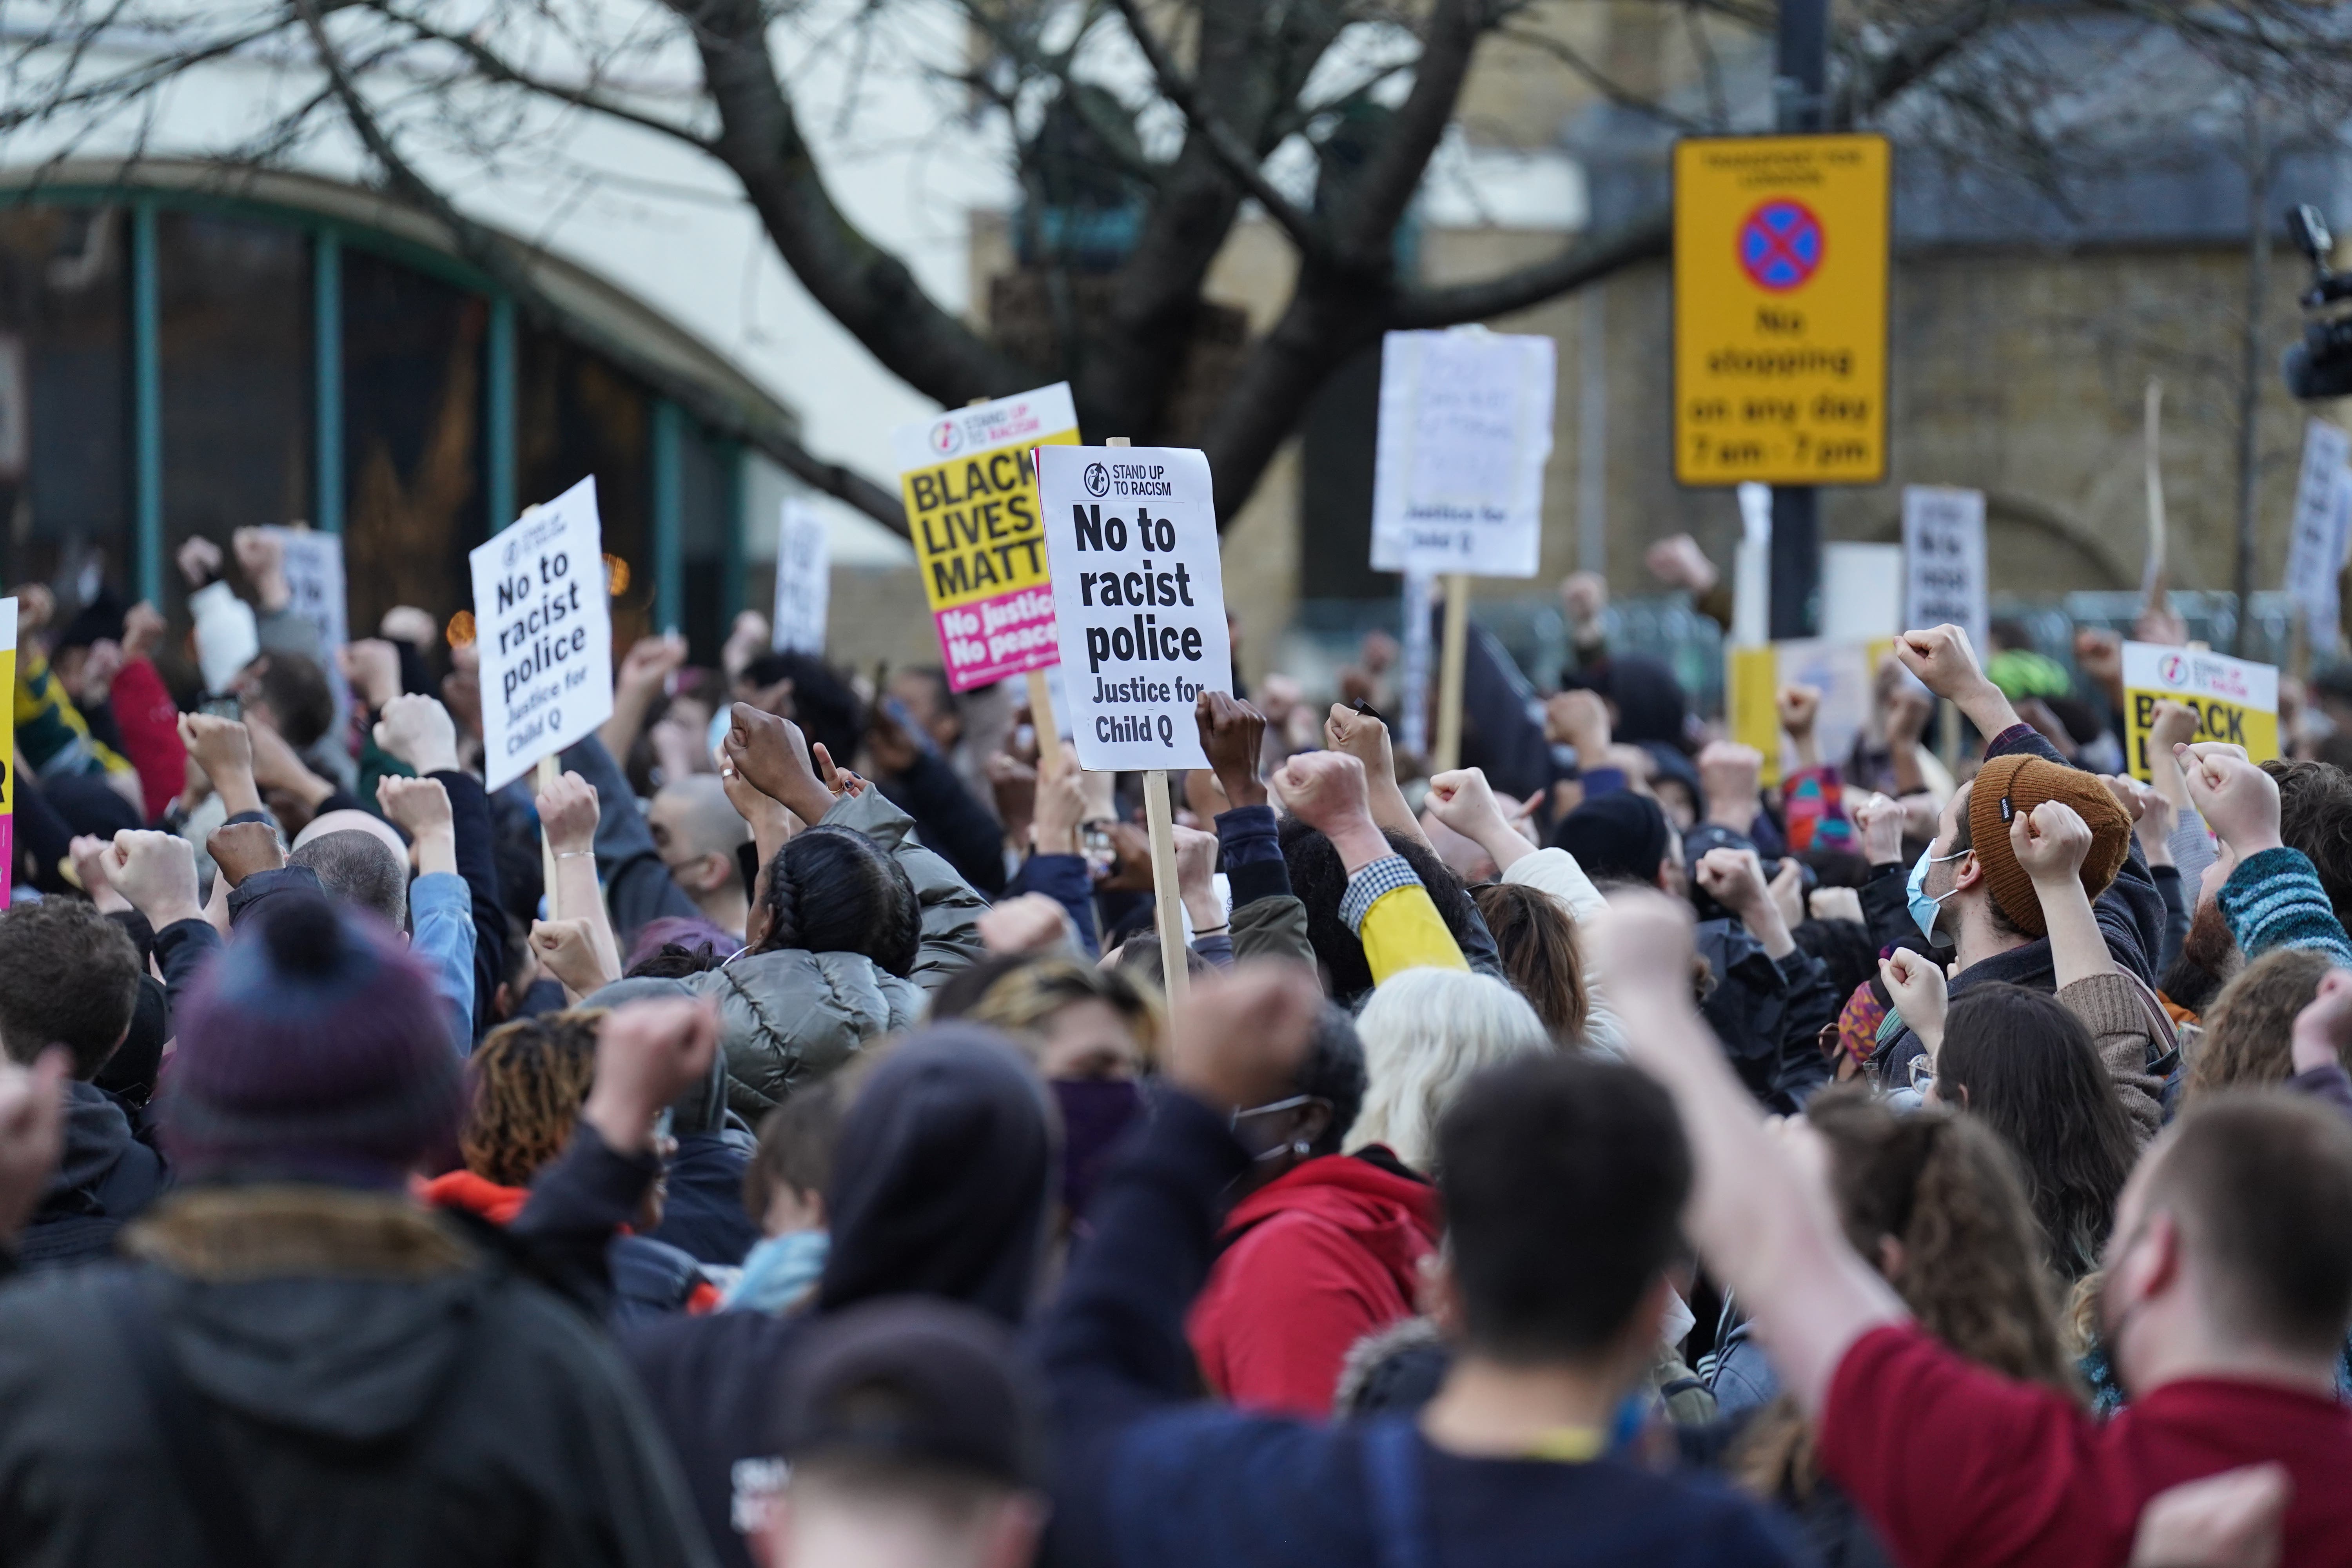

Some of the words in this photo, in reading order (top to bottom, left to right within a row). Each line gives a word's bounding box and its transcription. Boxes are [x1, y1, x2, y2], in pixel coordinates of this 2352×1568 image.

[1113, 465, 1146, 479] STAND
[1149, 465, 1164, 479] UP
[1114, 481, 1128, 495] TO
[1131, 481, 1171, 496] RACISM
[922, 496, 1034, 555] LIVES
[1073, 505, 1127, 552] No
[1137, 508, 1175, 552] to
[498, 575, 529, 615] No
[540, 553, 568, 584] to
[1080, 559, 1194, 607] racist
[499, 581, 580, 655] racist
[942, 609, 979, 640] No
[504, 626, 585, 704] police
[949, 637, 987, 669] No
[1086, 614, 1202, 673] police
[506, 682, 559, 729] Justice
[565, 666, 586, 690] for
[1093, 676, 1171, 703] Justice
[1175, 676, 1204, 704] for
[507, 714, 543, 755] Child
[549, 708, 561, 731] Q
[1096, 715, 1152, 743] Child
[1158, 715, 1173, 748] Q
[2136, 695, 2245, 745] BACK
